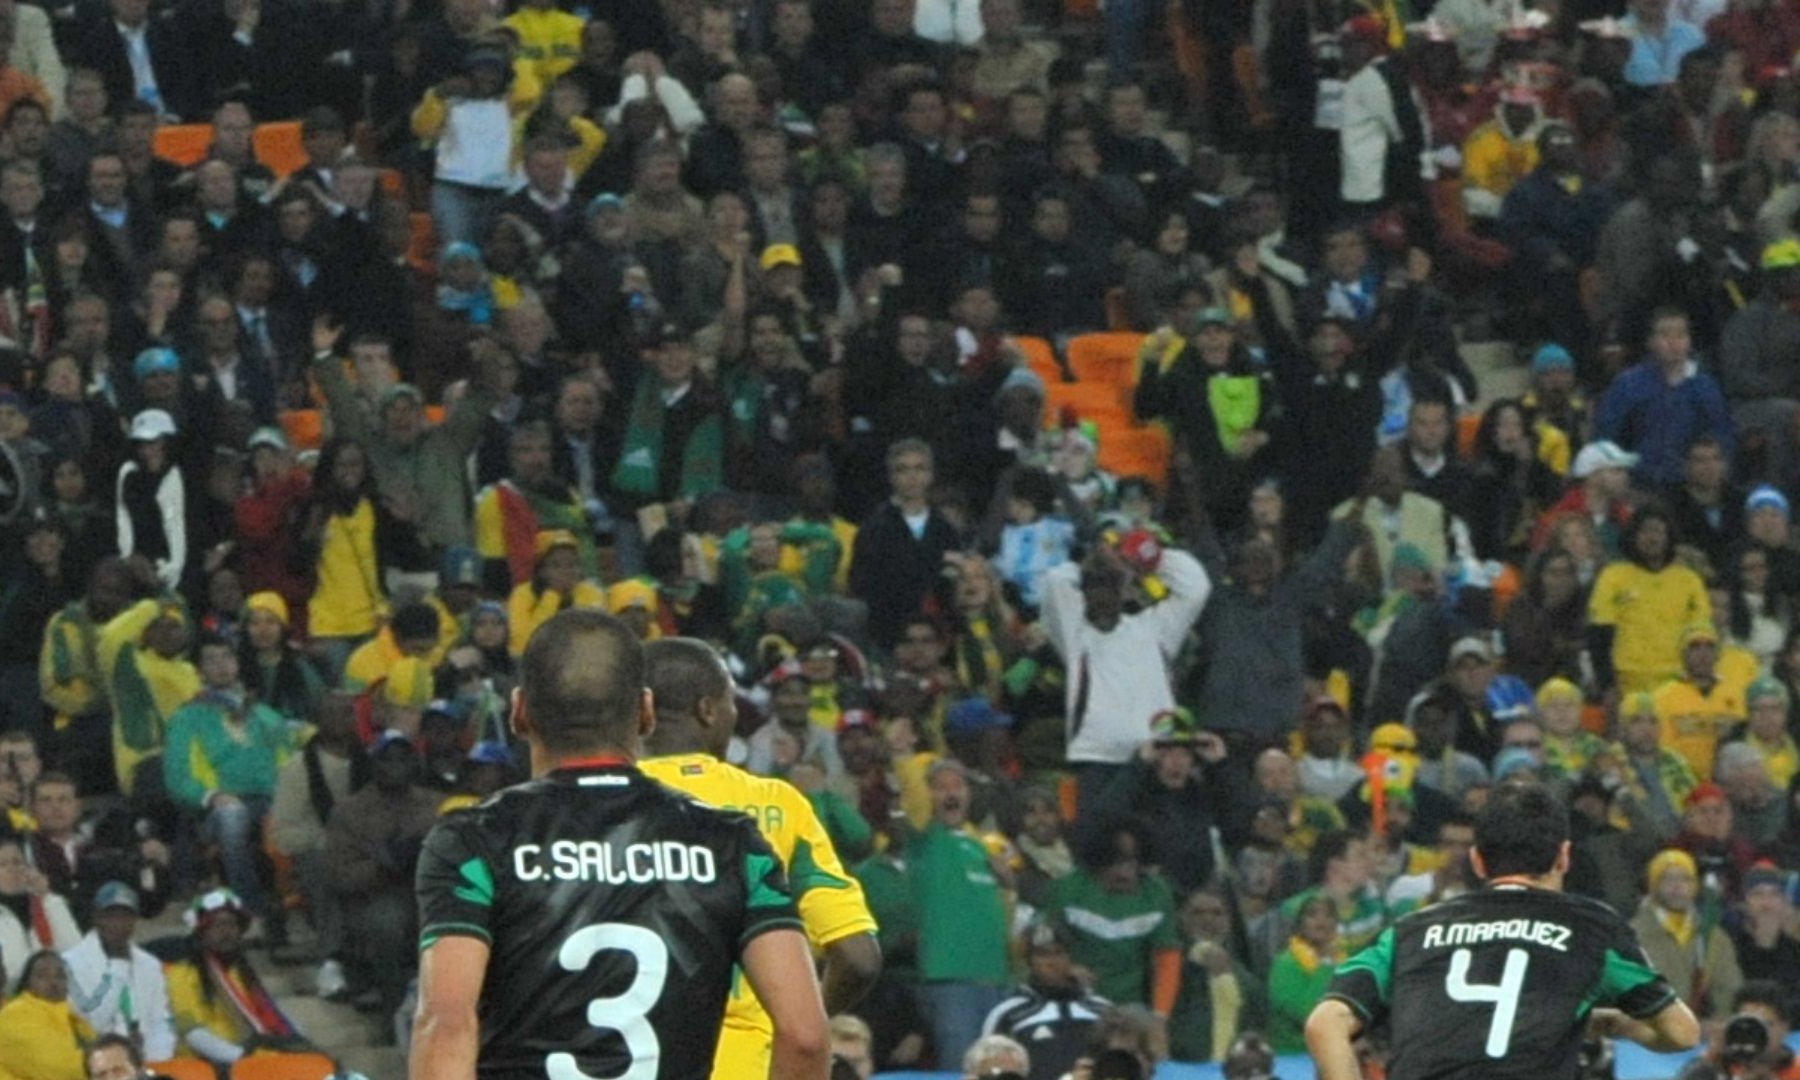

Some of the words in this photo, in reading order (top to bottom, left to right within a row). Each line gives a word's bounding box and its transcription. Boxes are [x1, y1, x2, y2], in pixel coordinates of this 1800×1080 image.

[513, 840, 717, 885] C.SALCIDO
[1423, 919, 1572, 951] R.MARQUEZ
[1445, 948, 1529, 1058] 4
